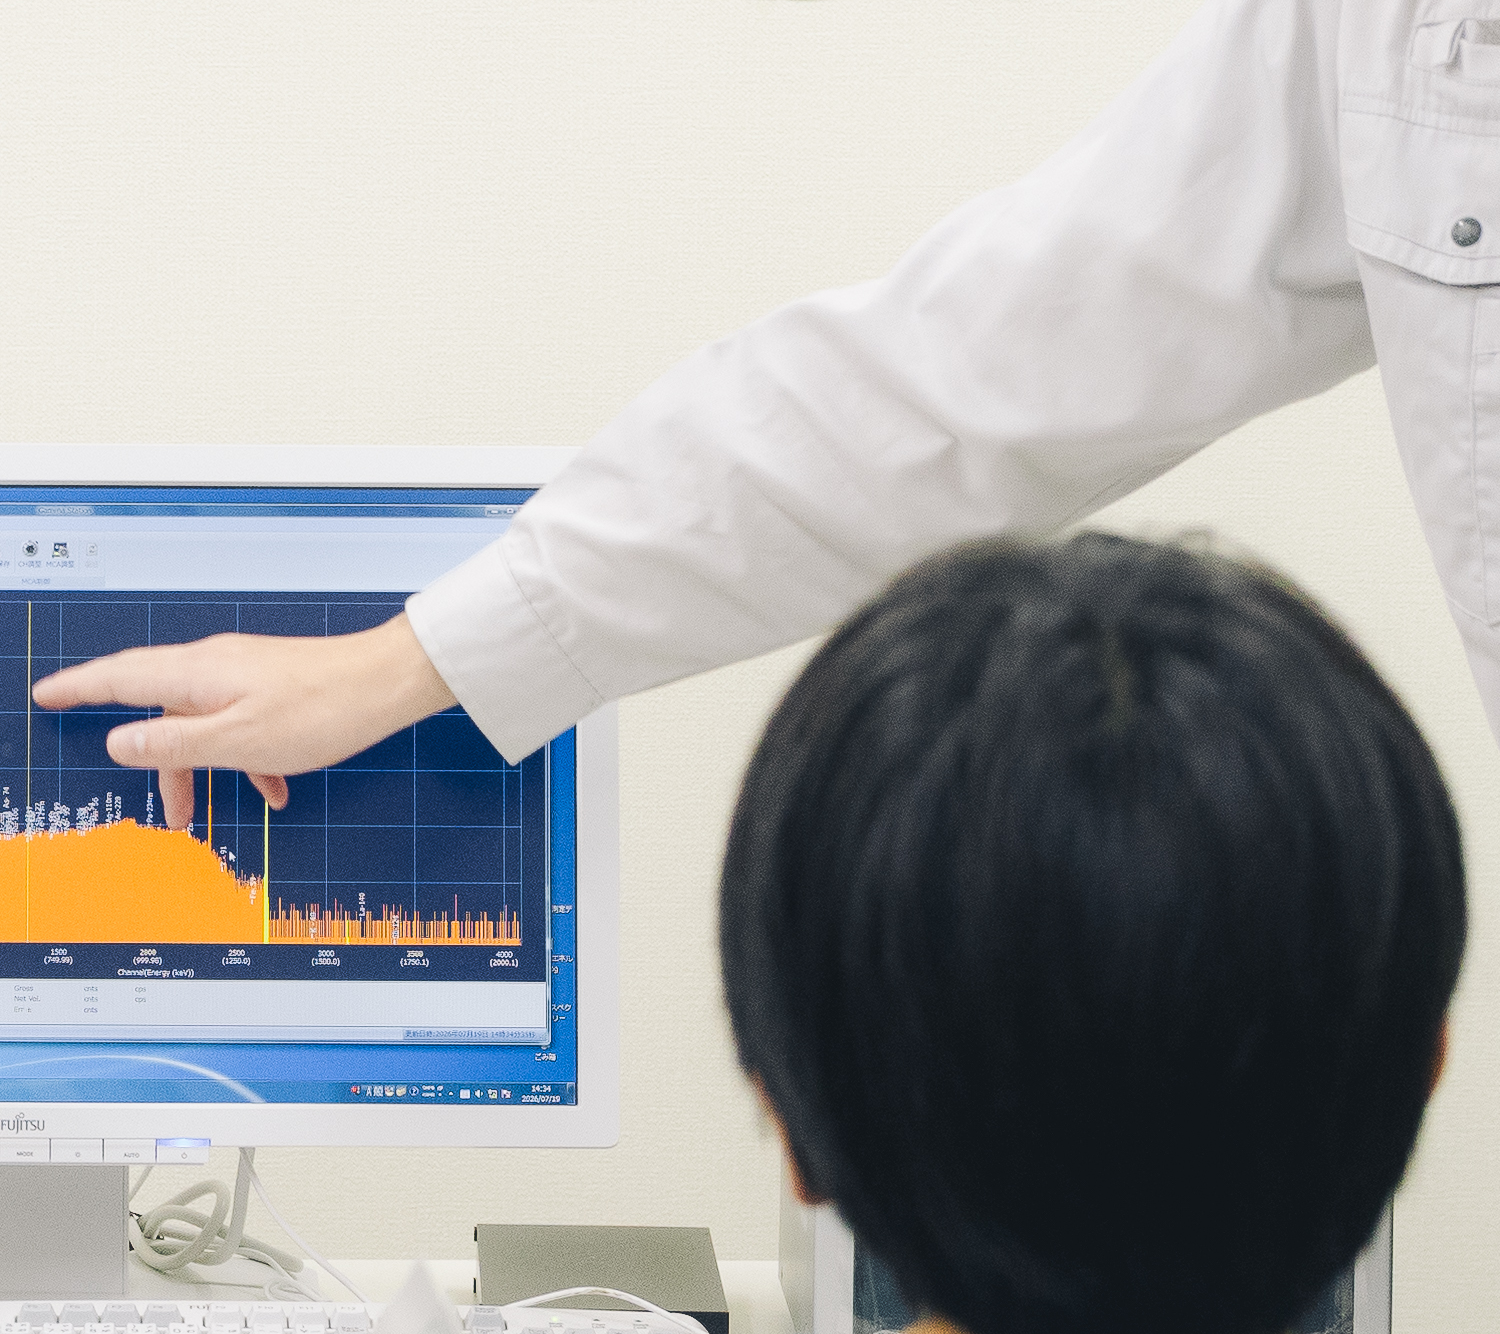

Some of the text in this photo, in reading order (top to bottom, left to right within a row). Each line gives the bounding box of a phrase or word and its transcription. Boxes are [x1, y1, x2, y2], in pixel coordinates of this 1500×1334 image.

[534, 1052, 557, 1062] ごみ箱
[531, 1085, 551, 1093] 14:34
[521, 1094, 561, 1104] 2026/07/19
[0, 1116, 46, 1135] FUJITSU
